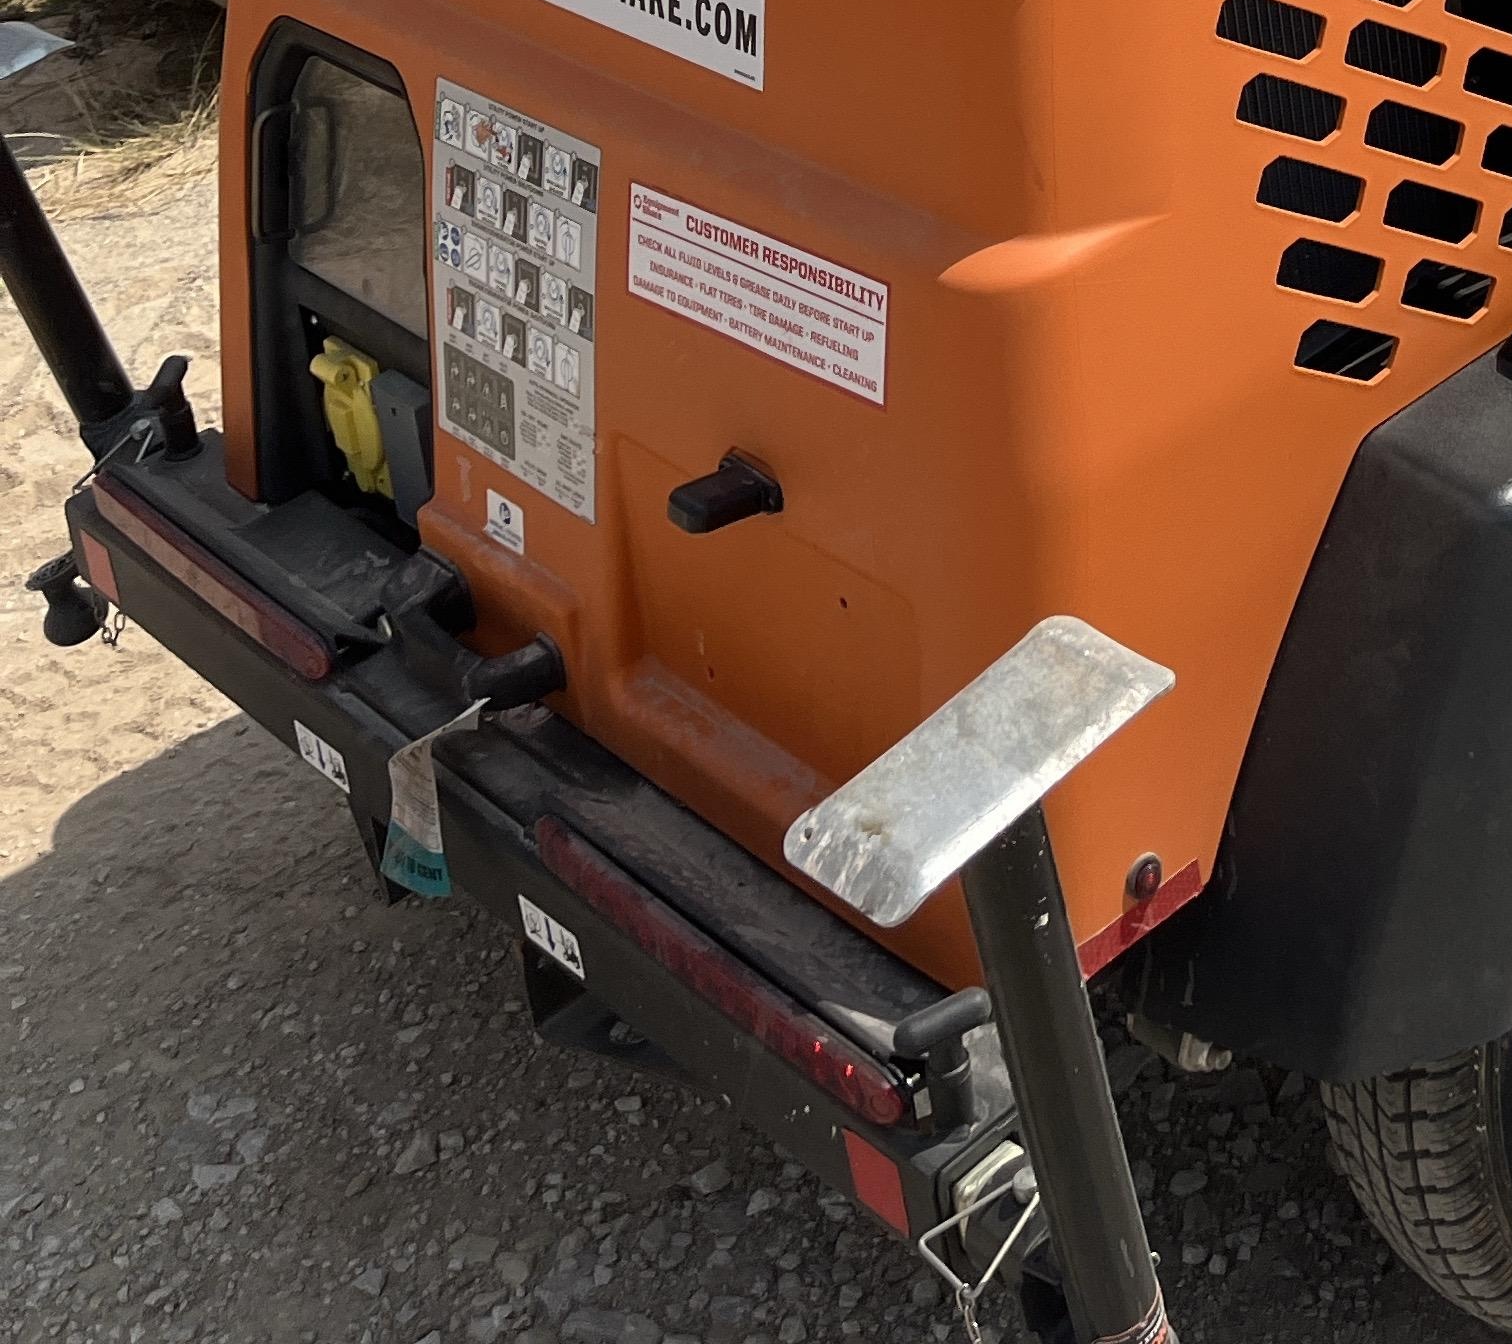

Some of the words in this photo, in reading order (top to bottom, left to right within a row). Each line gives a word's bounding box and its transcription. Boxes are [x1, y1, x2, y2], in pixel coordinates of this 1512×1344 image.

[686, 214, 759, 259] CUSTOMER
[762, 245, 885, 312] RESPONSIBILITY
[832, 315, 860, 337] START
[861, 328, 875, 343] UP
[832, 363, 878, 393] CLEANING
